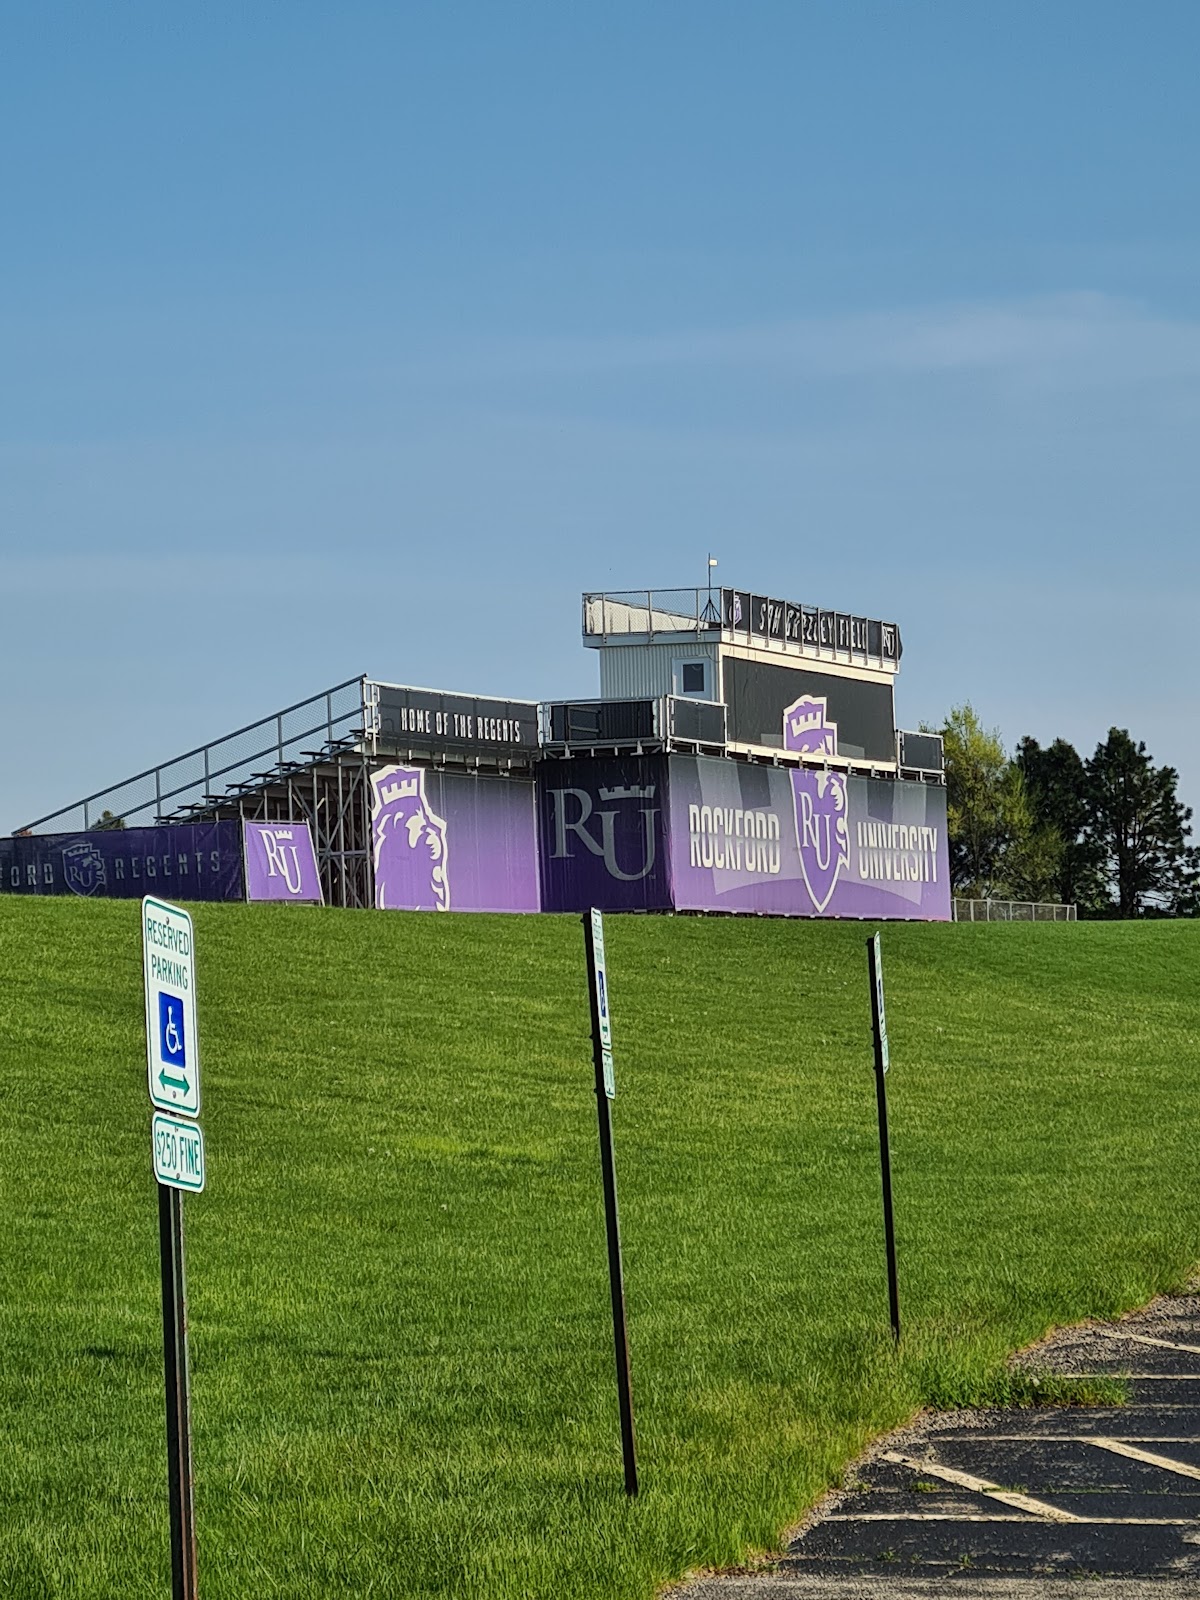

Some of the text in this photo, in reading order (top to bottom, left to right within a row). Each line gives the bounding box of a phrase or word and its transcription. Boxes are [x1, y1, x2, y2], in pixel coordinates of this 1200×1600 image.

[401, 707, 520, 742] HOME OF THE REGENTS
[546, 788, 660, 881] RU
[688, 804, 938, 883] ROCKFORD UNIVERSITY
[799, 791, 831, 870] RU
[0, 863, 54, 888] ORD
[115, 851, 221, 880] REGENTS
[258, 829, 301, 894] RU
[147, 917, 190, 957] RESERVED
[151, 953, 188, 991] PARKING
[156, 1130, 200, 1176] $250 FINE
